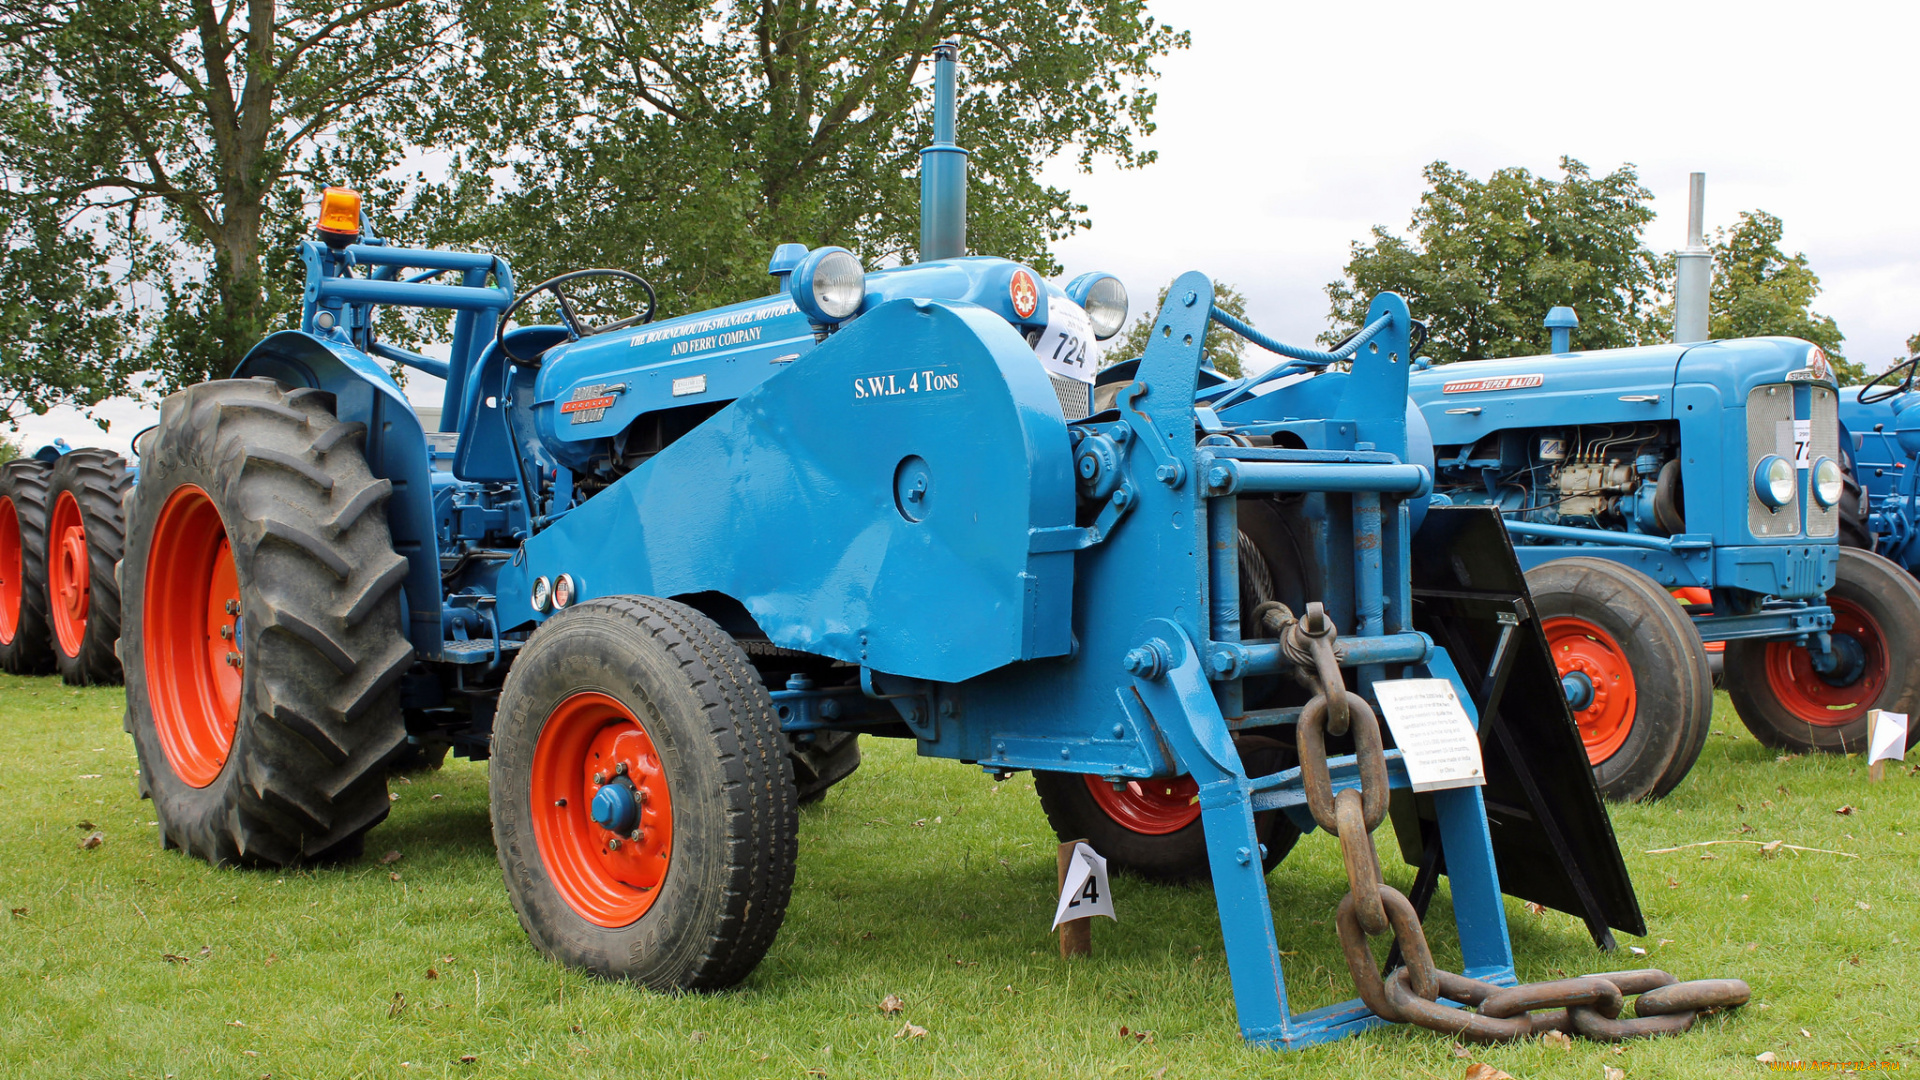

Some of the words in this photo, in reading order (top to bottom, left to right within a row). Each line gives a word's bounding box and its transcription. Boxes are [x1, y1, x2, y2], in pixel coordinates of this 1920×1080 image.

[630, 335, 645, 347] THE
[646, 312, 753, 343] BOURNEMOUTH-SWANAGE
[755, 305, 788, 321] MOTOR
[671, 340, 689, 356] AND
[689, 336, 716, 353] FERRY
[718, 326, 762, 347] COMPANY
[1052, 333, 1087, 368] 724
[854, 375, 906, 399] S.W.L.
[909, 372, 919, 393] 4
[1480, 379, 1509, 389] SUPER
[1509, 376, 1540, 387] MAJOR
